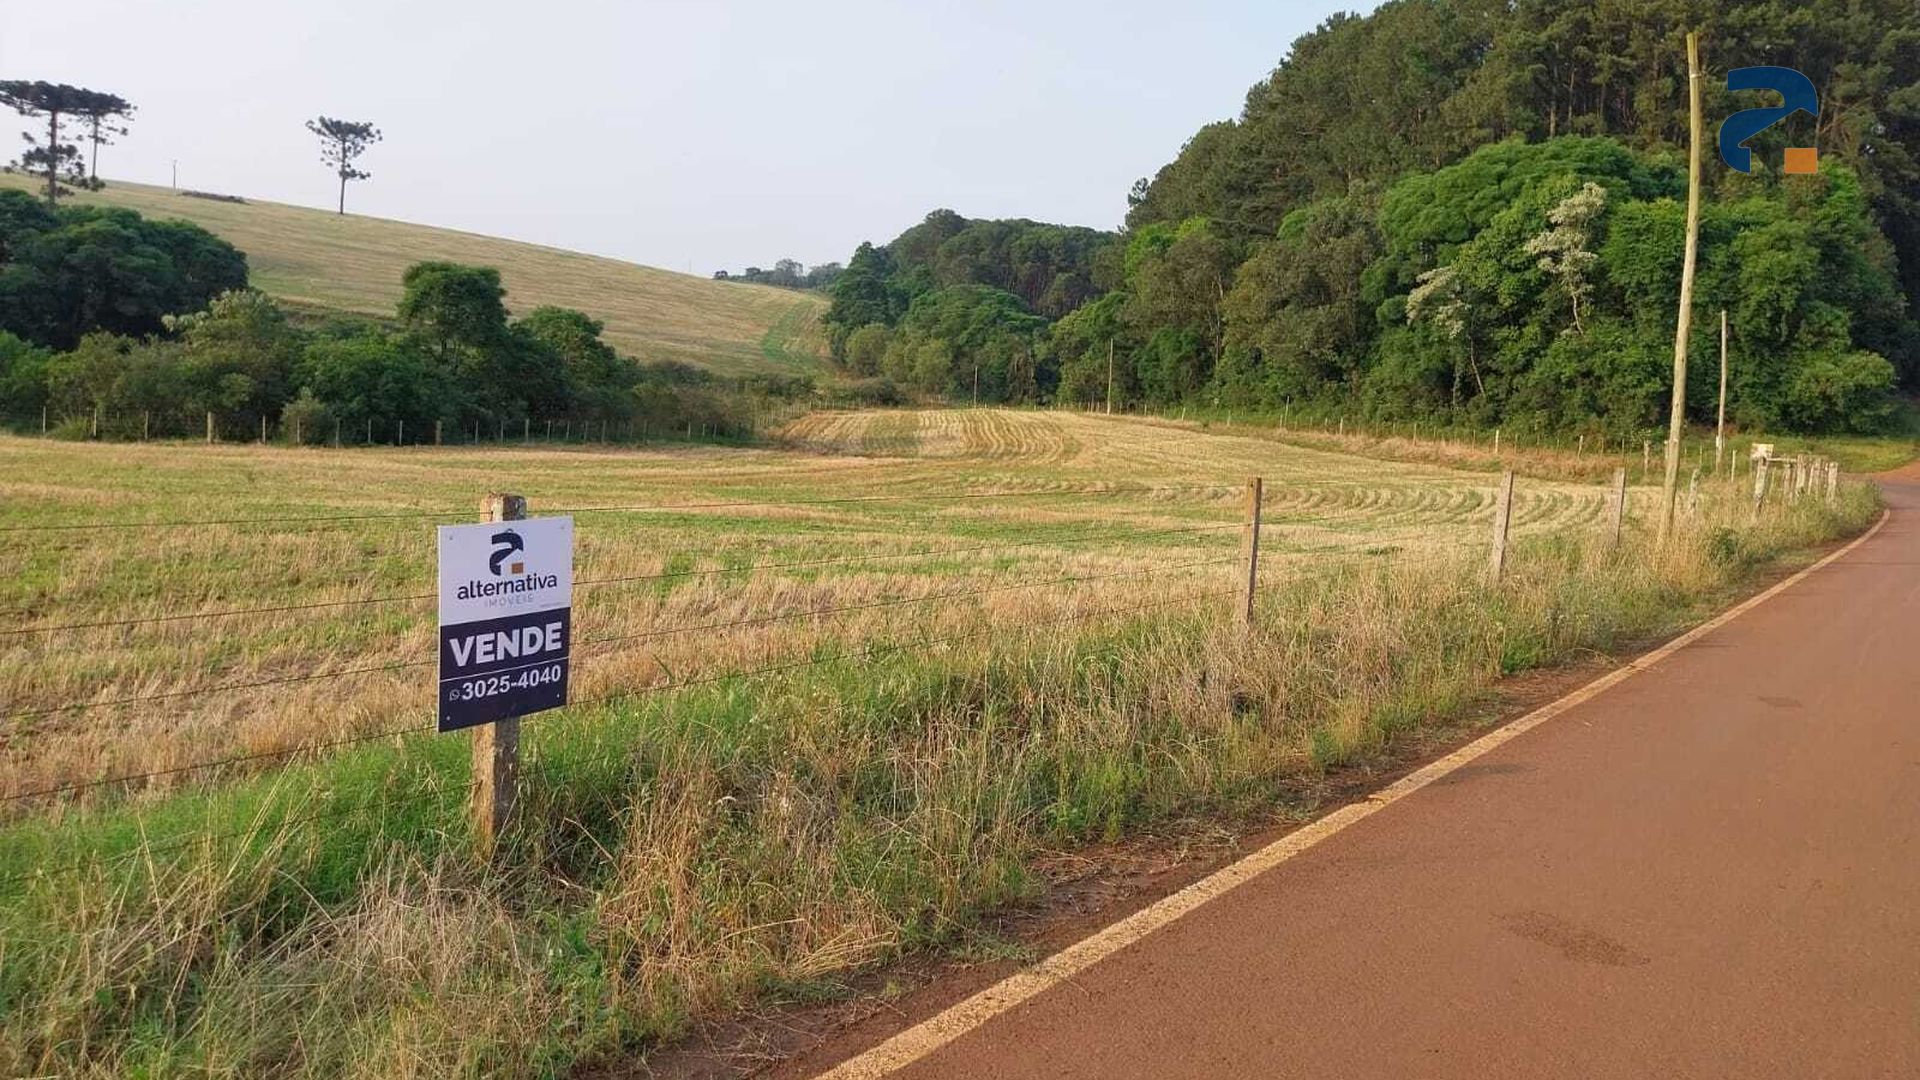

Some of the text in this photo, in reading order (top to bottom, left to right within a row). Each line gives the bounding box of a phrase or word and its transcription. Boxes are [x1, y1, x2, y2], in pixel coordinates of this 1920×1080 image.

[457, 572, 558, 600] alternativa
[449, 621, 562, 667] VENDE
[461, 665, 562, 700] 3025-4040
